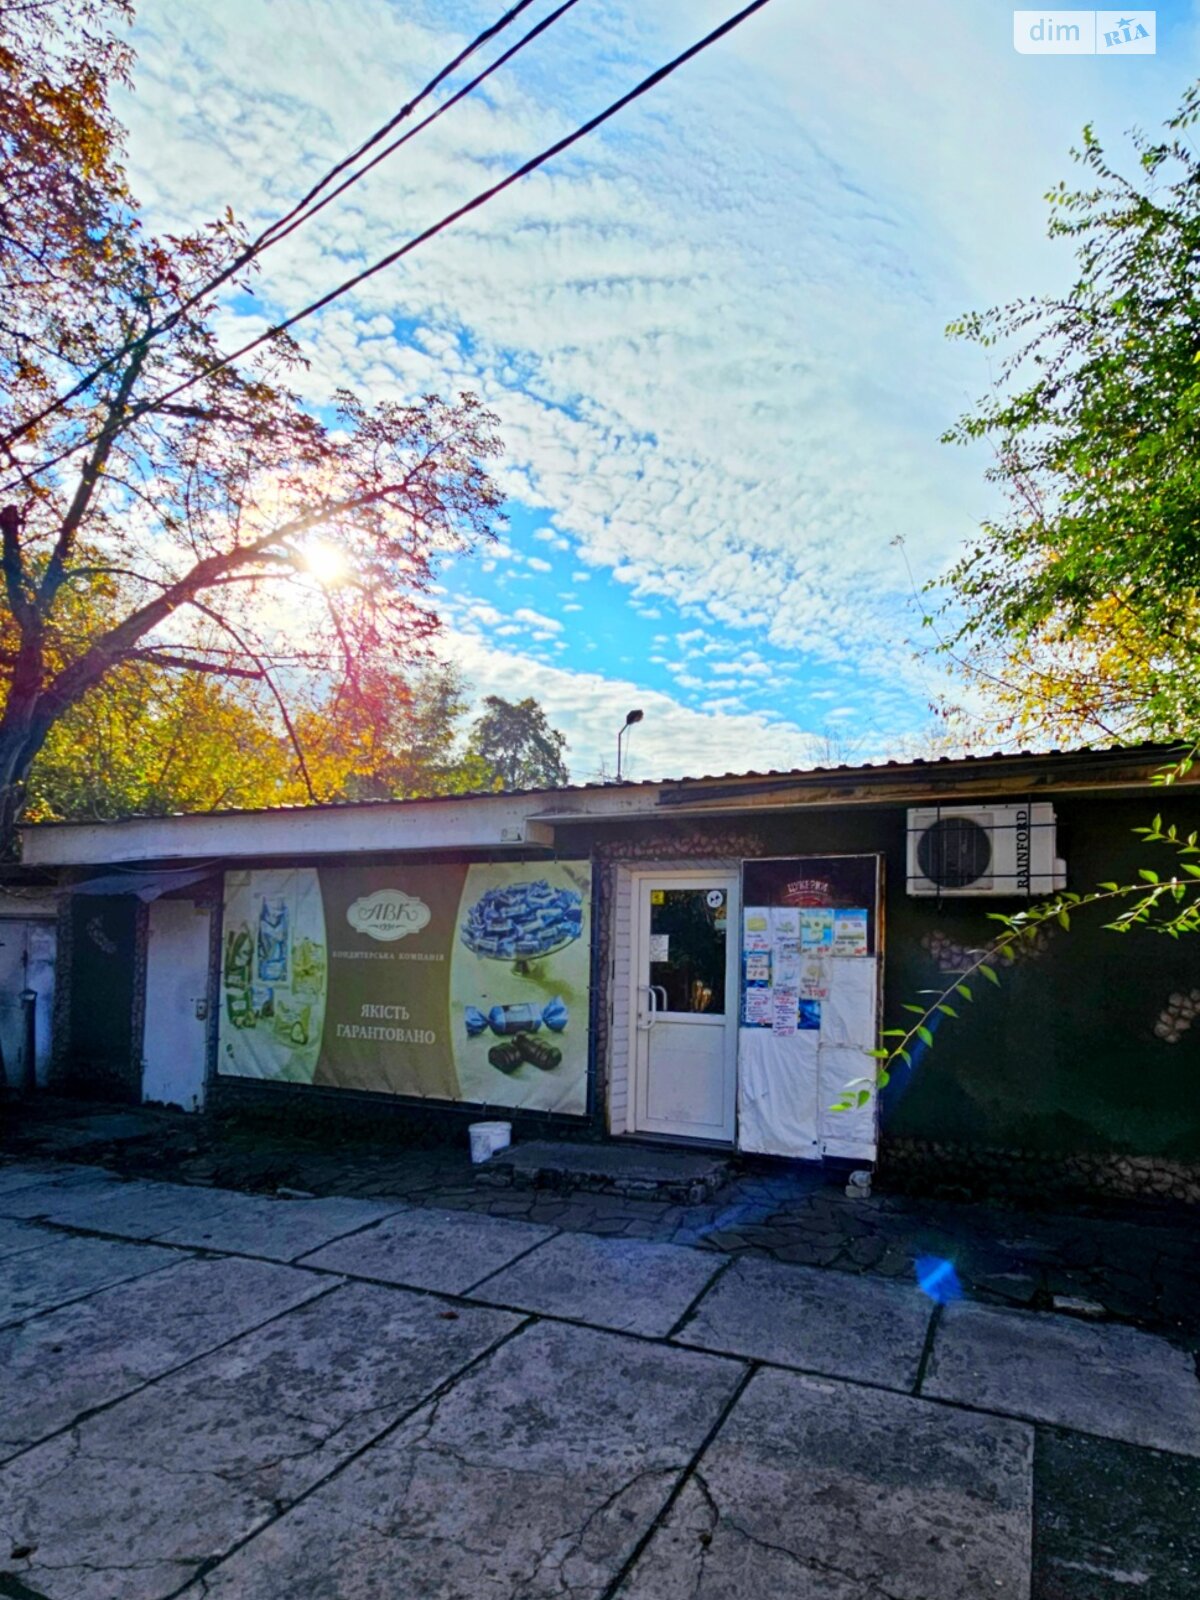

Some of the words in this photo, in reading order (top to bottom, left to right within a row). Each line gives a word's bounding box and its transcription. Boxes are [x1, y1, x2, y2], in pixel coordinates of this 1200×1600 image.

[1016, 810, 1029, 890] RAINFORD
[358, 902, 419, 921] АВК
[332, 950, 395, 960] КОНДИТЕРСЬКА
[398, 952, 444, 961] КОМПАНІЯ
[360, 1004, 410, 1020] ЯКІСТЬ
[336, 1023, 435, 1045] ГАРАНТОВАНО
